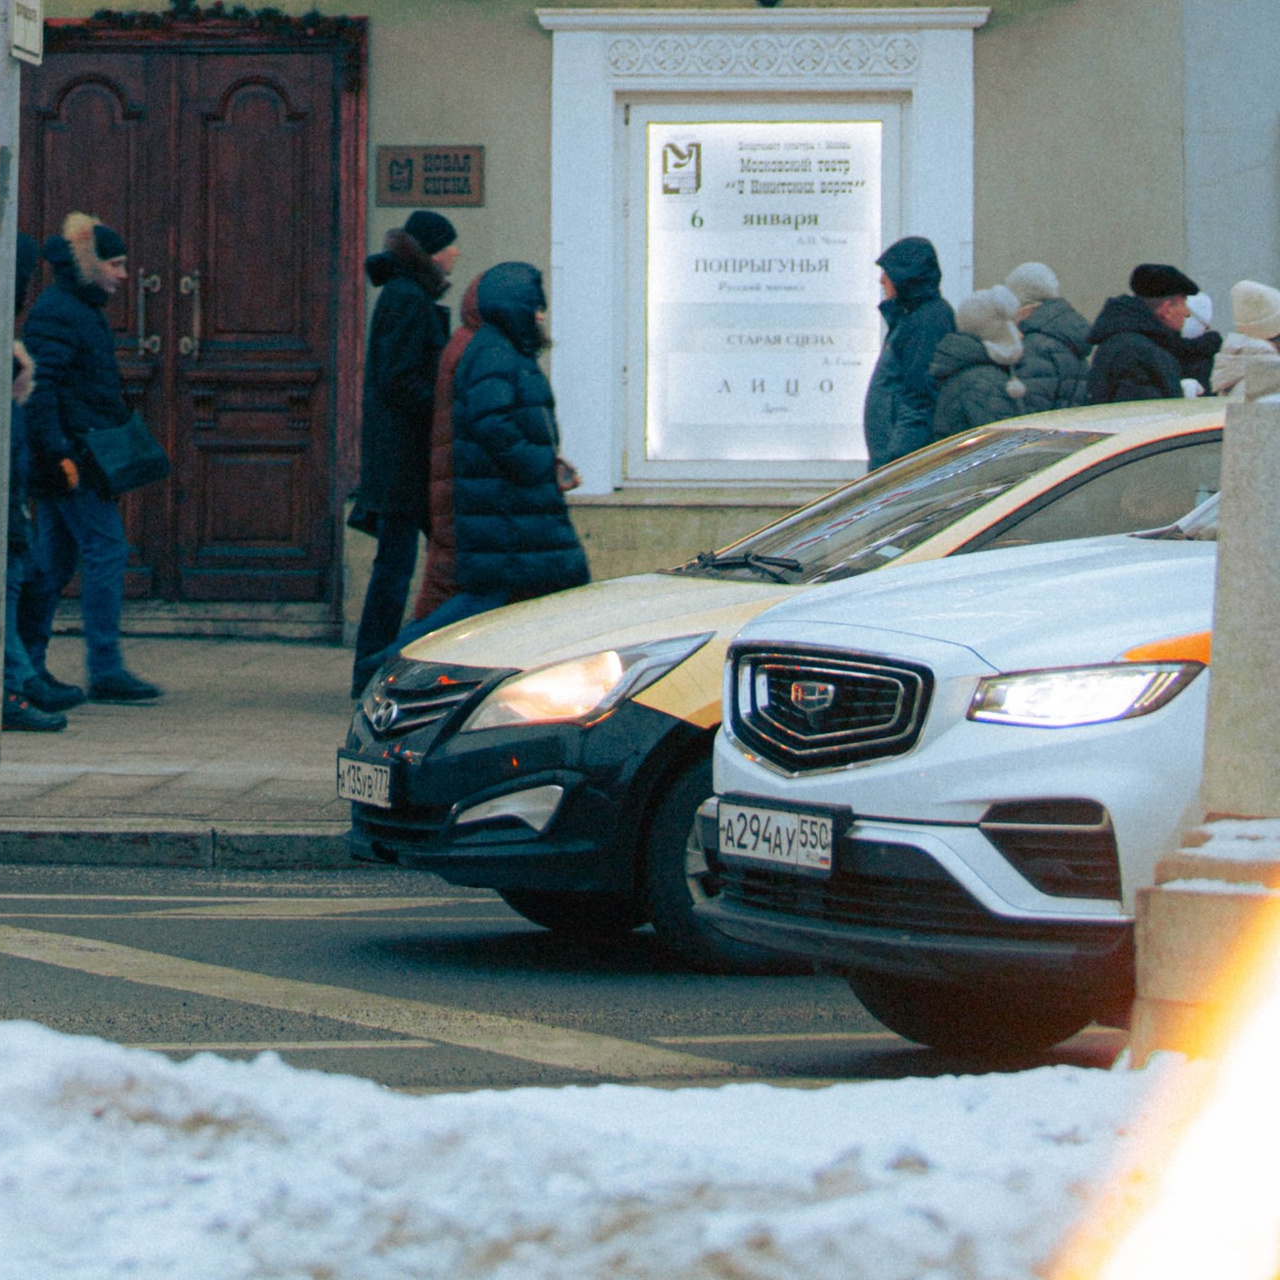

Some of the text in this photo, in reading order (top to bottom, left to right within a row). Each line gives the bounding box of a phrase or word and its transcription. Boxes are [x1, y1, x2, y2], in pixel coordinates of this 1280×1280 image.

[691, 209, 819, 230] 6 января
[695, 258, 830, 274] ПОПРЫГУНЬЯ
